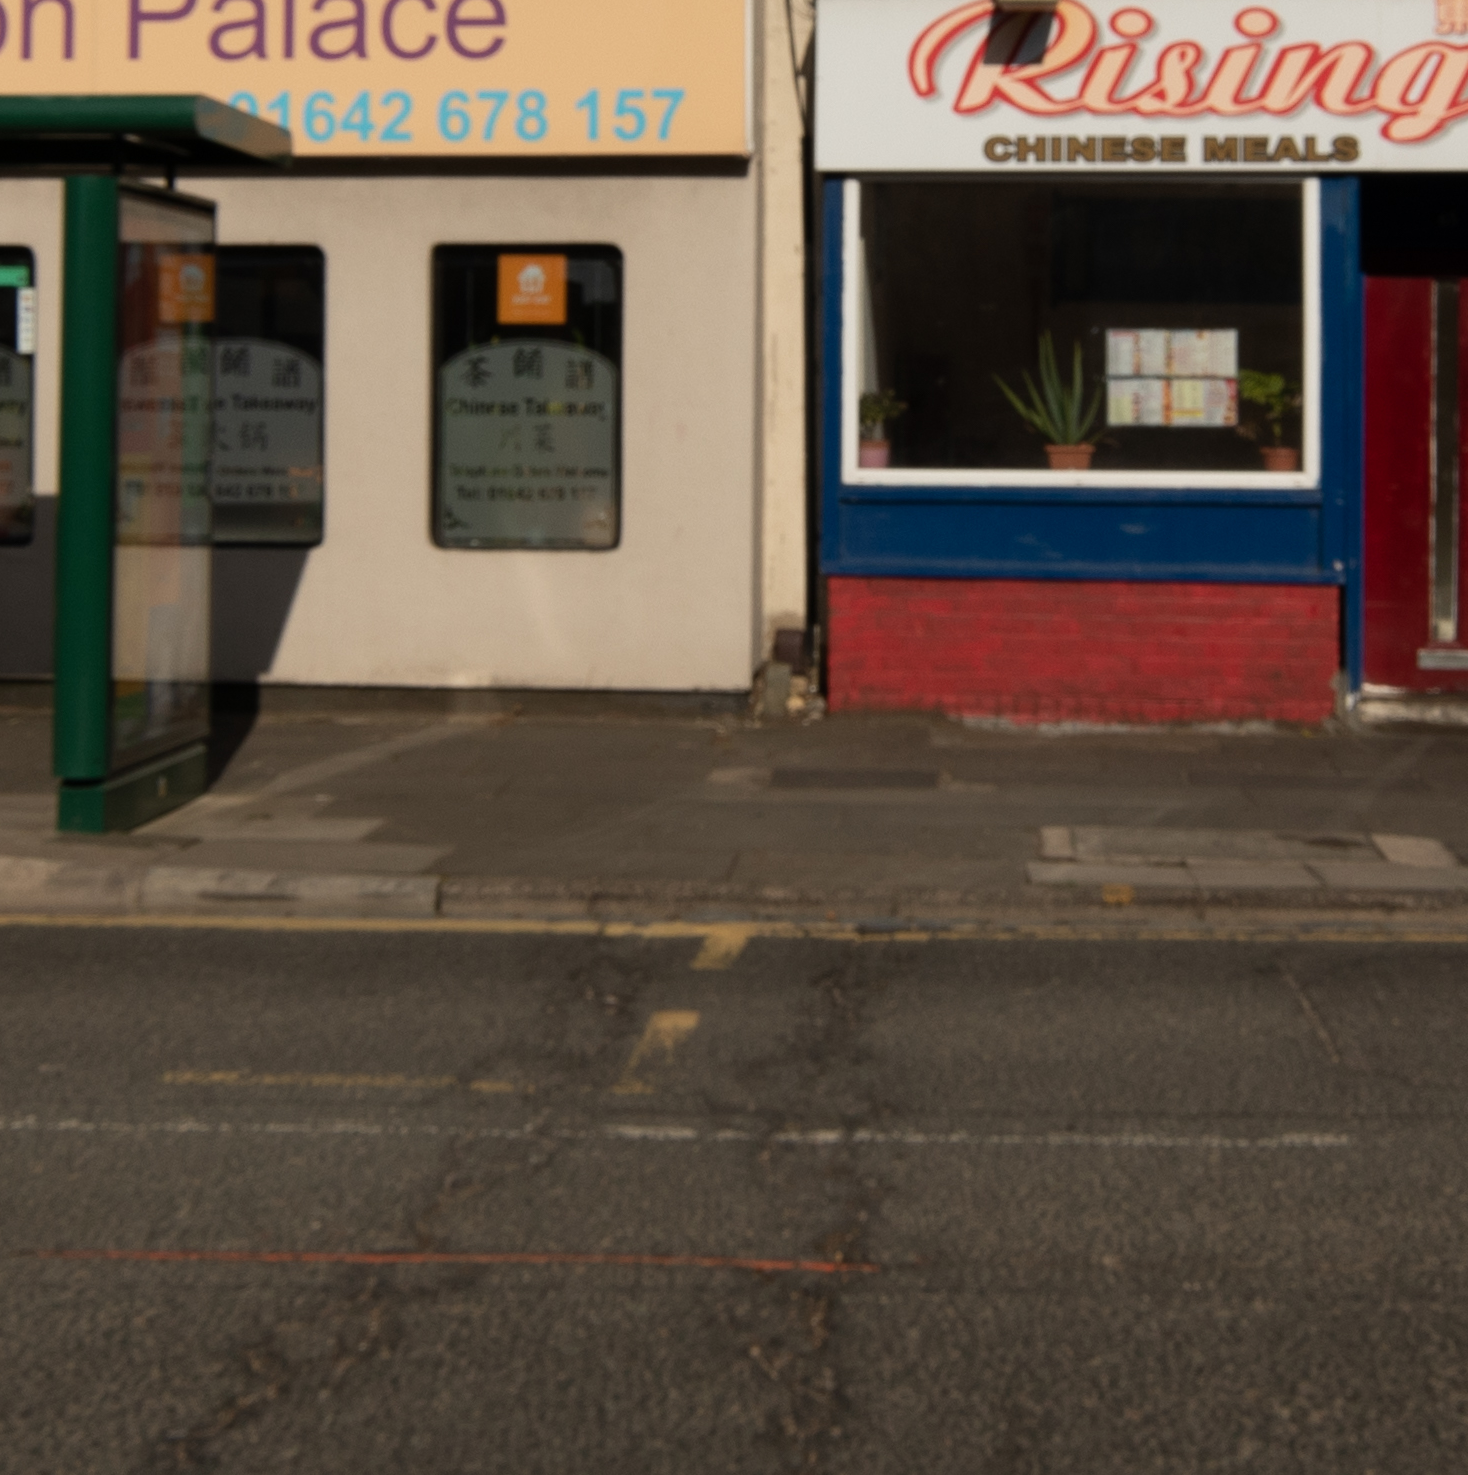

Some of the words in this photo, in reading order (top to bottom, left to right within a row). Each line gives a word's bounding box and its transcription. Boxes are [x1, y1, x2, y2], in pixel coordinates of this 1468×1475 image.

[436, 89, 549, 143] 678
[575, 88, 686, 142] 157
[983, 135, 1188, 164] CHINESE
[1203, 135, 1360, 164] MEALS
[524, 396, 607, 422] Takaway
